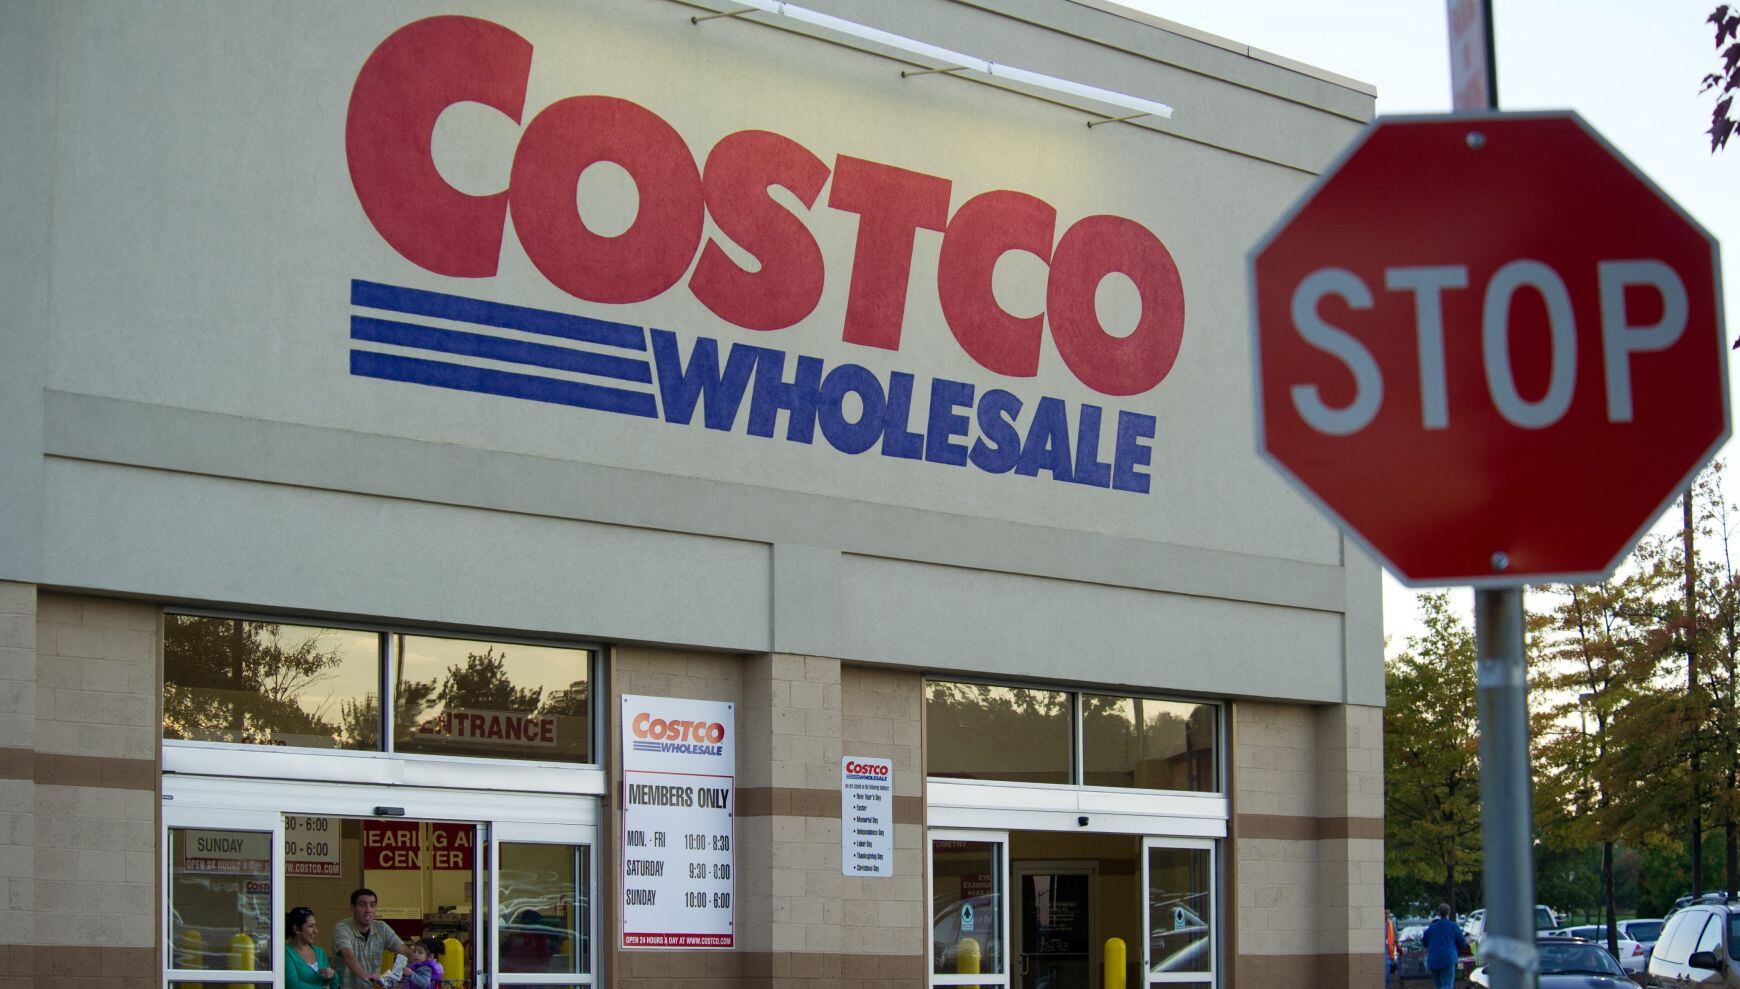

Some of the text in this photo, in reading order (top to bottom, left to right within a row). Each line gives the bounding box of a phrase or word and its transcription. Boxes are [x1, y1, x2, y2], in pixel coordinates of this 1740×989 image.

[345, 15, 1185, 396] COSTCO
[1290, 259, 1690, 436] STOP
[650, 328, 1157, 495] WHOLESALE
[632, 712, 725, 744] COSTCO
[661, 743, 723, 756] WHOLESALE
[846, 761, 888, 775] COSTCO
[629, 784, 729, 809] MEMBERS ONLY
[285, 816, 296, 830] 30
[306, 817, 328, 831] 6:00
[197, 837, 244, 853] SUNDAY
[363, 830, 473, 847] EARIG AI
[627, 830, 647, 847] MON.
[654, 832, 666, 847] FRI
[685, 834, 706, 850] 10:00
[713, 835, 730, 851] 8:30
[285, 841, 296, 855] 00
[306, 842, 328, 856] 6:00
[186, 859, 205, 869] OPEN
[206, 860, 215, 869] 24
[218, 860, 240, 870] HOURS
[286, 863, 339, 873] W.COSTCO.COM
[379, 850, 463, 868] CENER
[626, 859, 665, 877] SATURDAY
[689, 863, 706, 879] 9:30
[626, 889, 656, 906] SUNDAY
[685, 892, 706, 907] 10:00
[713, 892, 730, 908] 6:00
[626, 936, 638, 944] OPEN
[639, 936, 646, 944] 24
[647, 936, 663, 944] HOURS
[686, 937, 731, 945] WWW.COSTCO.COM
